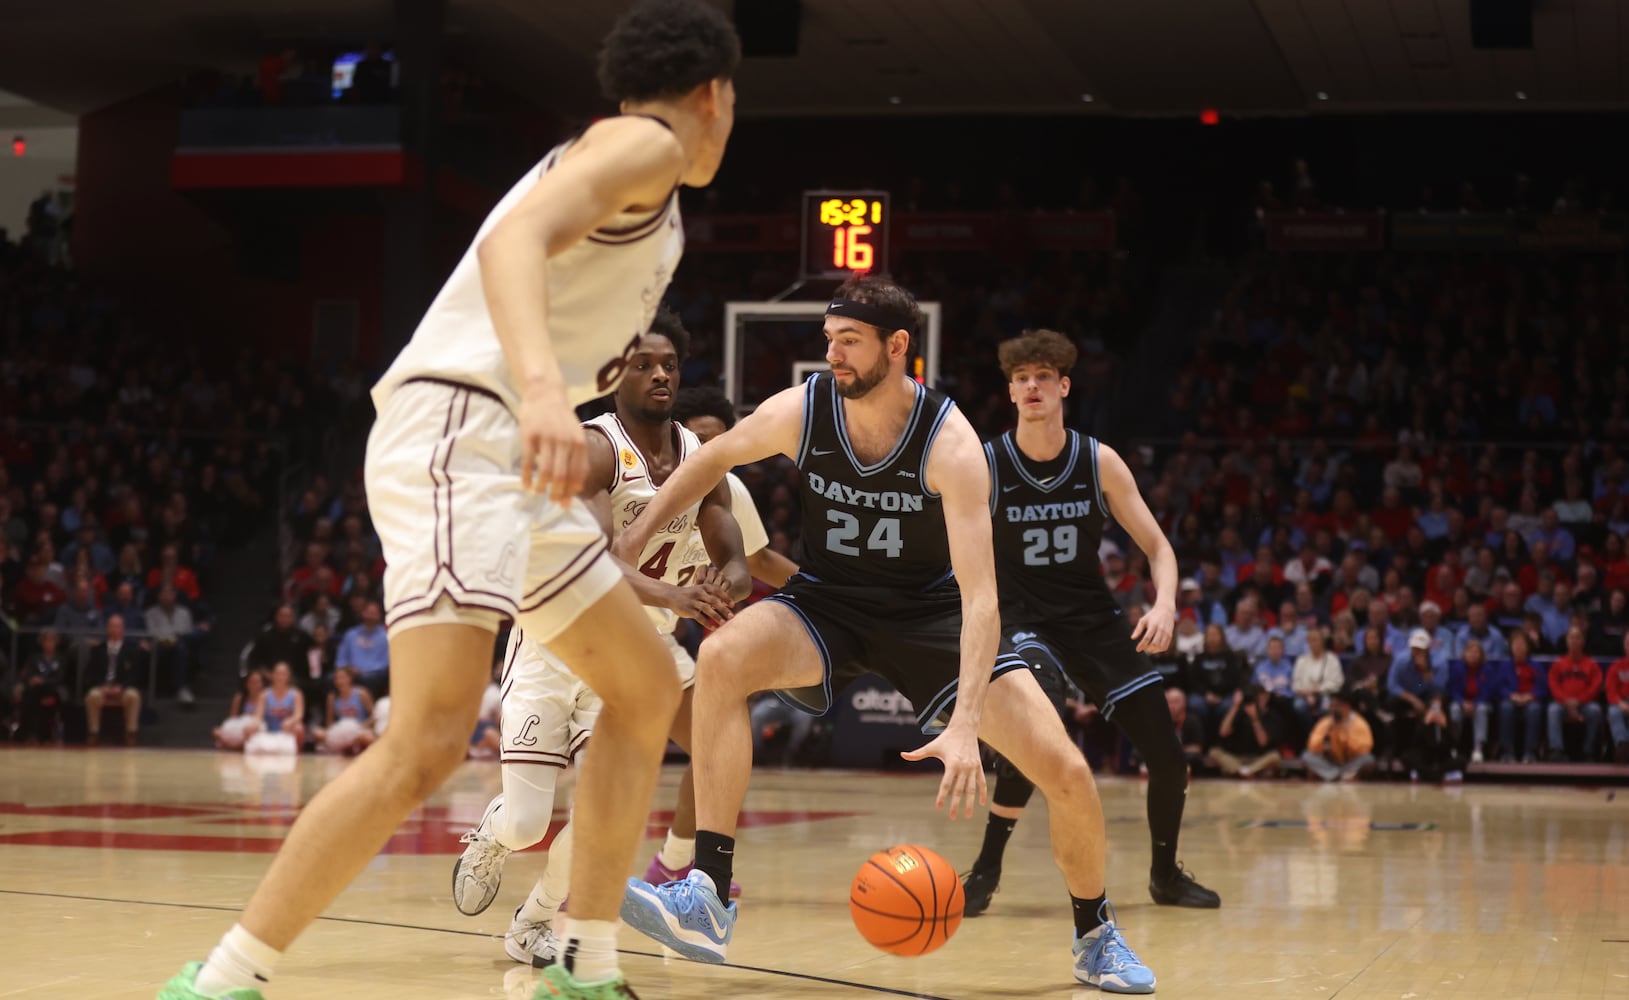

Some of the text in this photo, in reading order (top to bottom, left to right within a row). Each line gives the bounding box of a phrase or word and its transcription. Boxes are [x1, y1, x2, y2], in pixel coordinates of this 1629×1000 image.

[820, 198, 882, 226] 15:21
[834, 225, 874, 270] 16
[808, 471, 924, 513] DAYTON
[1006, 499, 1091, 522] DAYTON
[826, 508, 904, 558] 24
[1023, 524, 1078, 566] 29
[638, 541, 675, 580] 4
[512, 714, 541, 747] L
